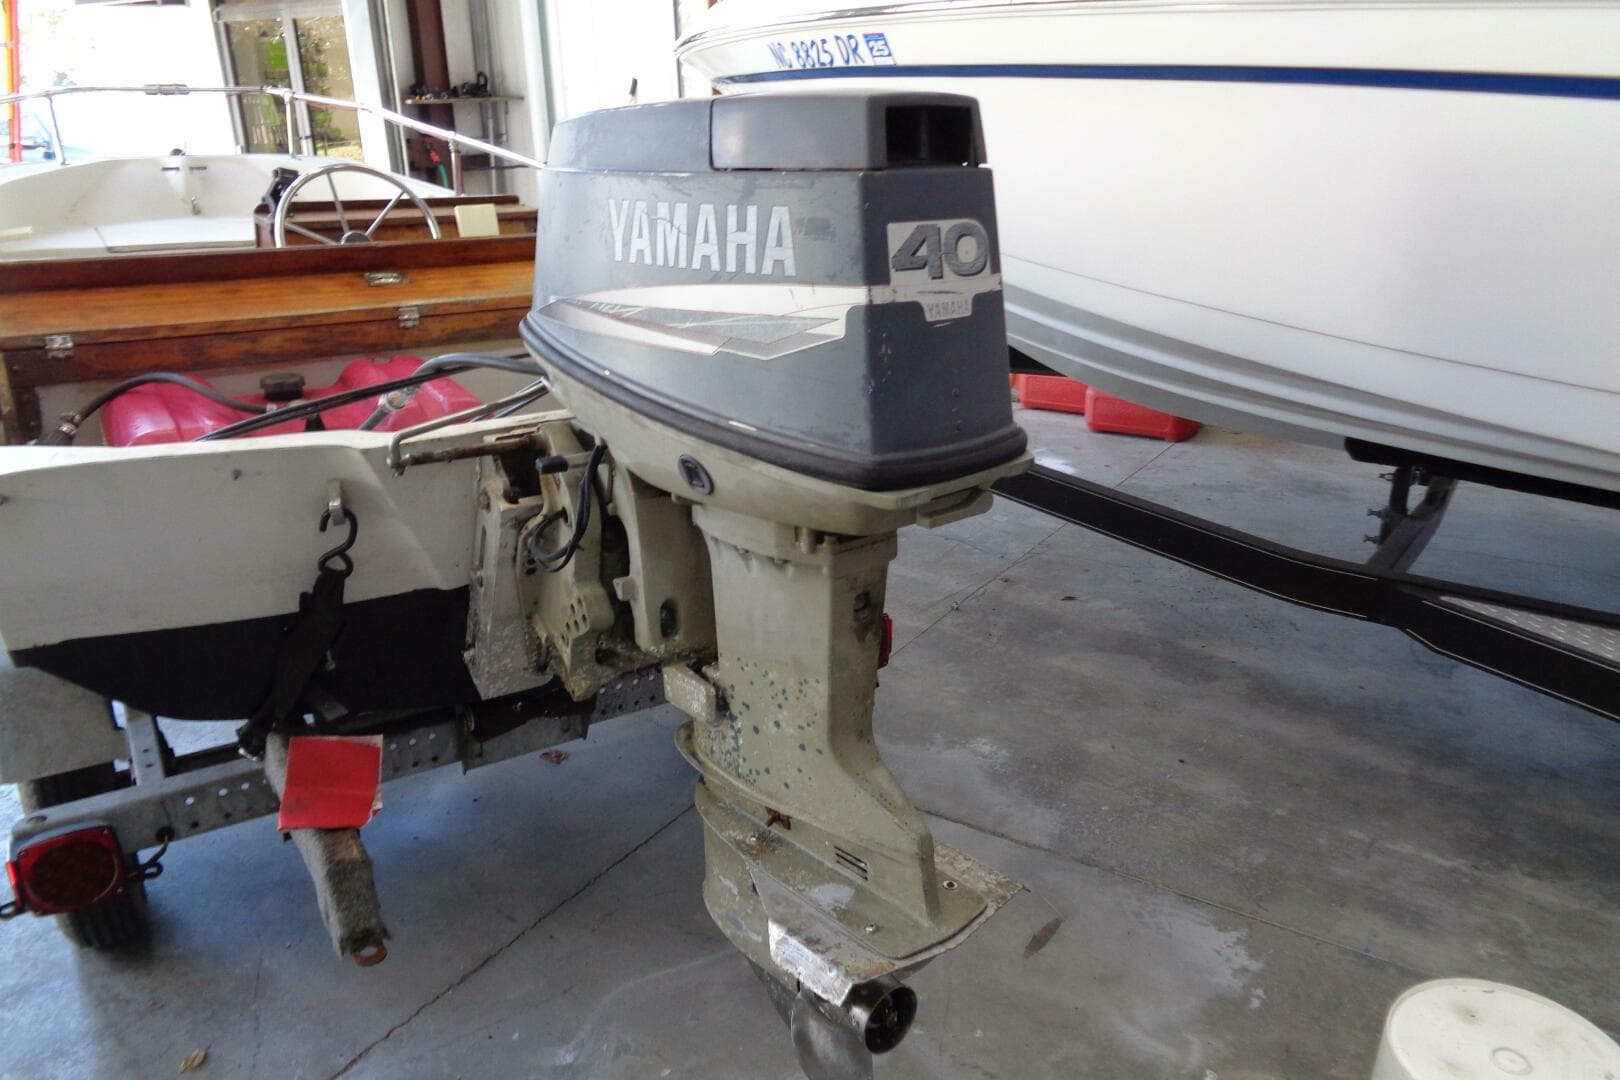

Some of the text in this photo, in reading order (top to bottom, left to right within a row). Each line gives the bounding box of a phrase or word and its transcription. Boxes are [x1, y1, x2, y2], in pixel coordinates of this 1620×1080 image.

[790, 39, 834, 68] 8825
[834, 34, 866, 66] DR
[868, 40, 891, 57] 25
[608, 199, 796, 277] YAMAHA
[891, 221, 989, 280] 40
